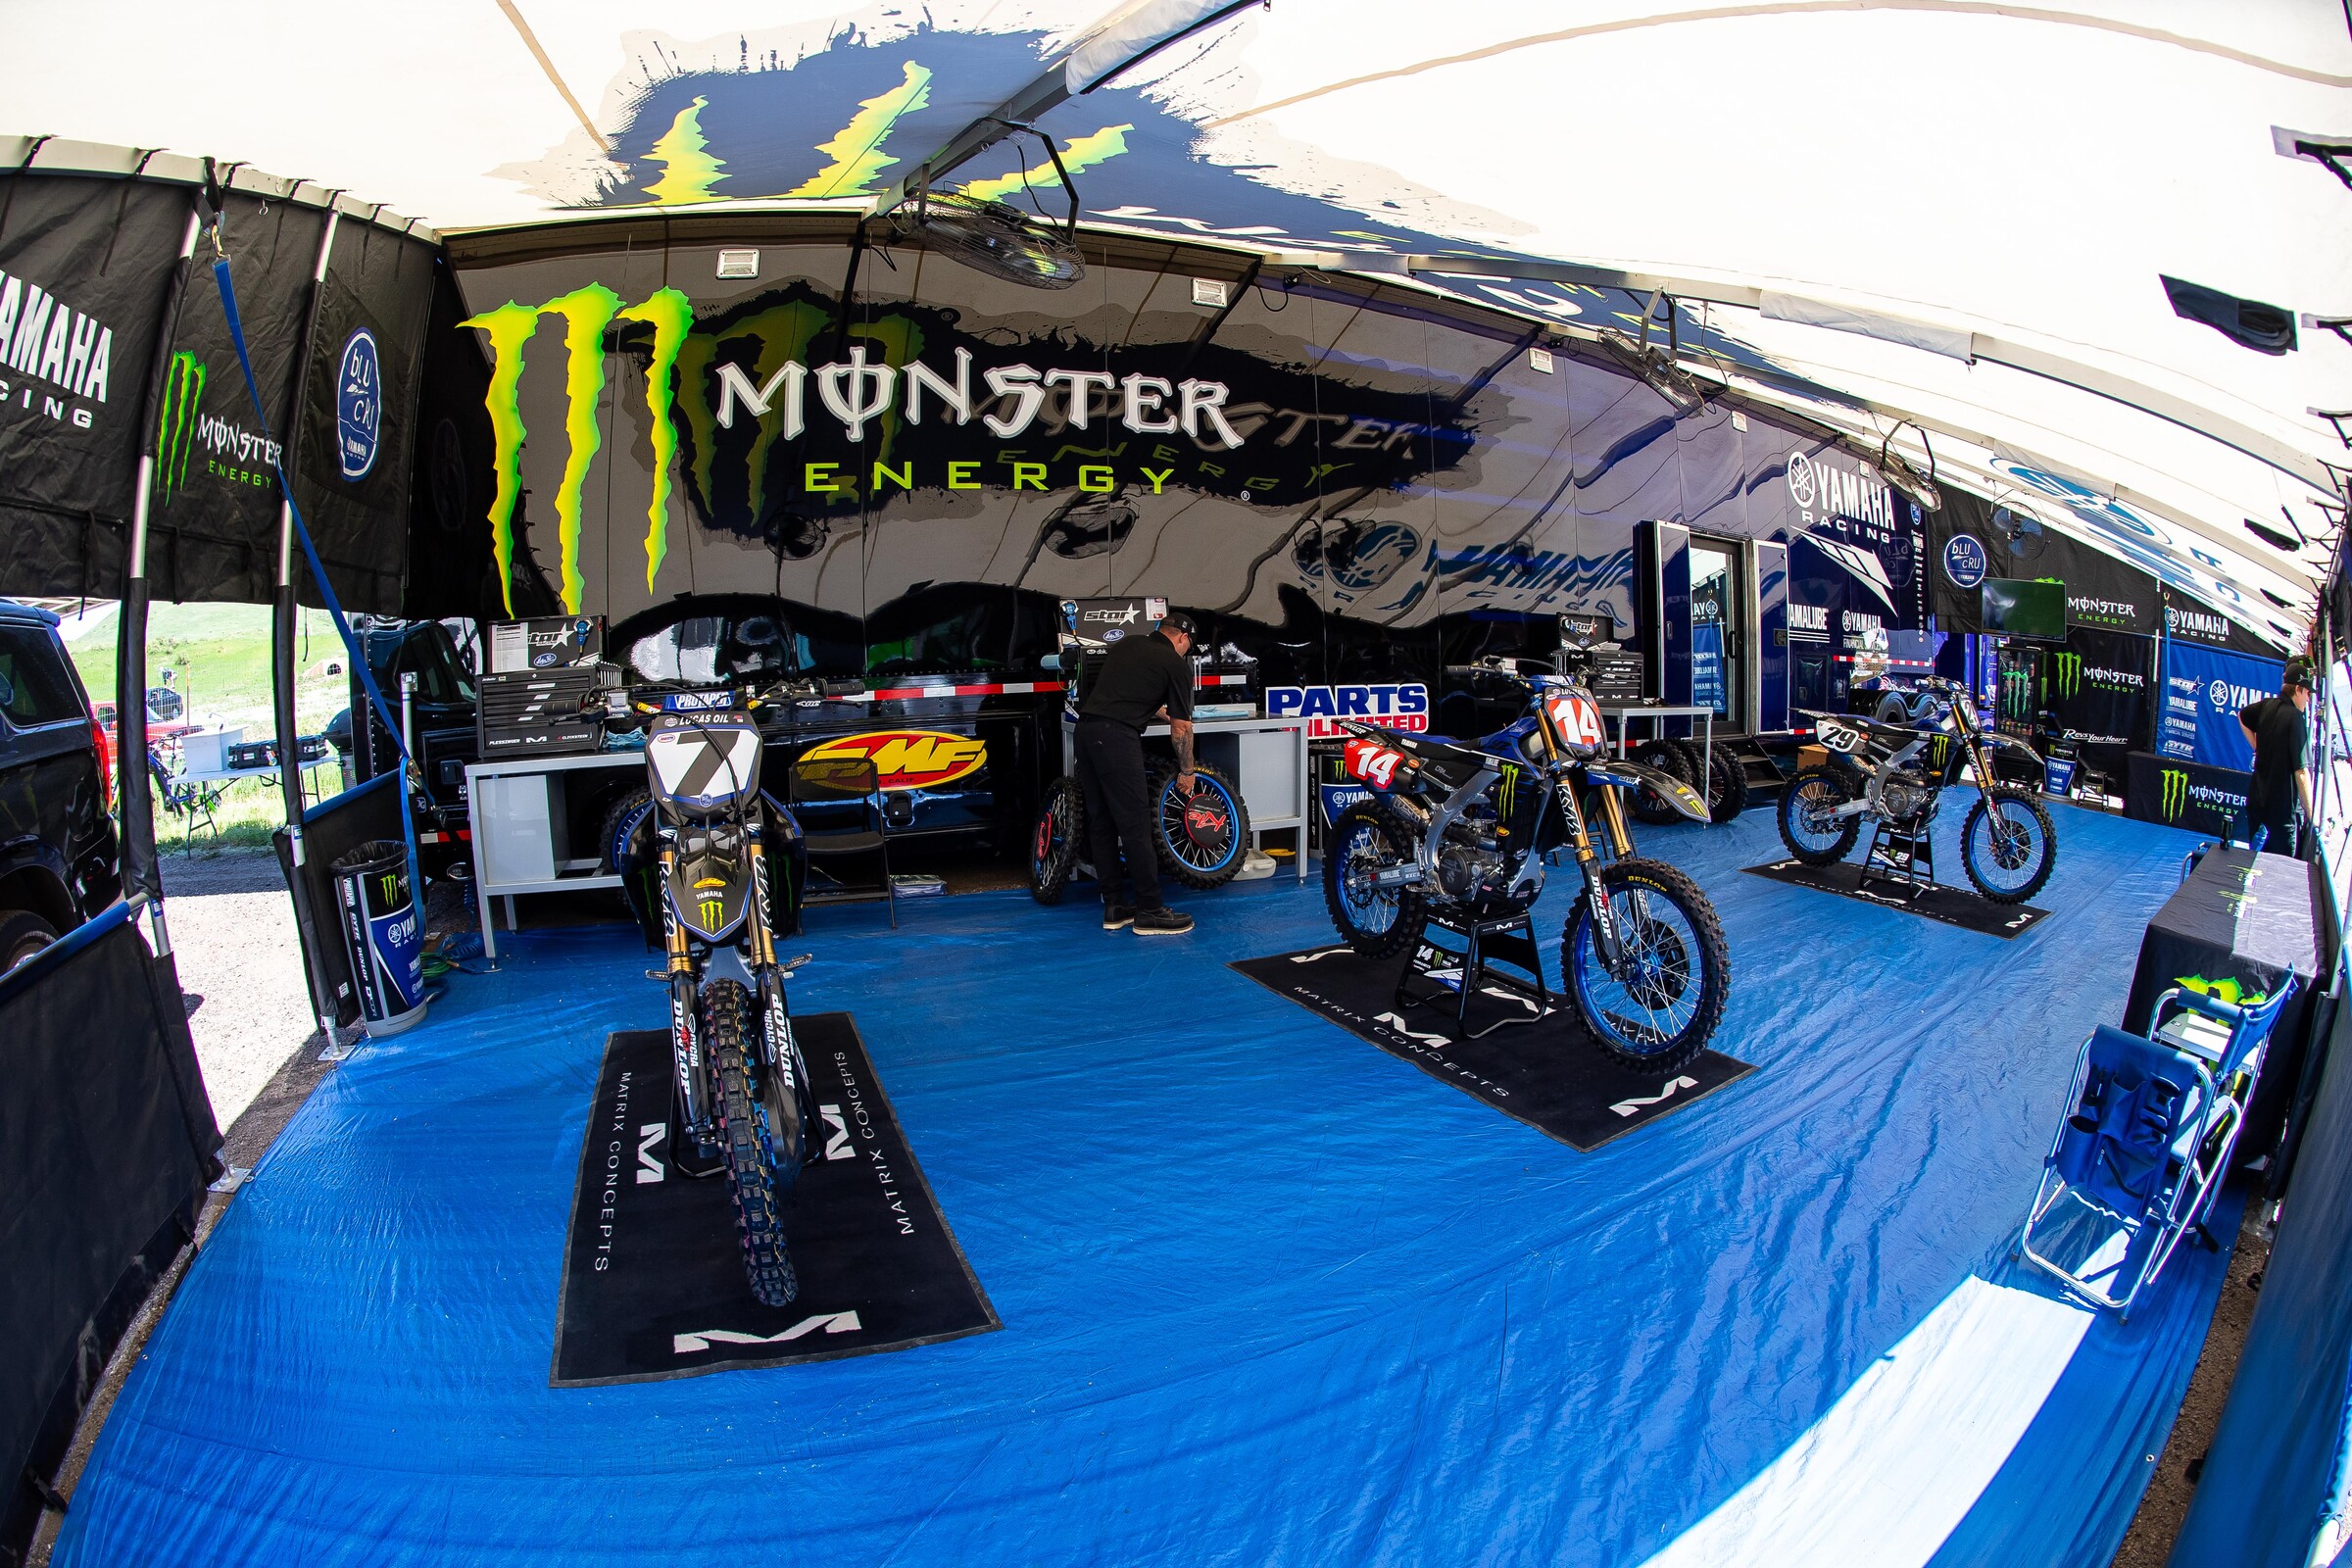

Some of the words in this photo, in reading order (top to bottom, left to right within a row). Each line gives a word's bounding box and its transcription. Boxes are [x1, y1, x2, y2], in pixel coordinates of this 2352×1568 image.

[0, 269, 113, 403] AMAHA
[714, 346, 1246, 449] MONSTER
[197, 413, 283, 470] MONSTER
[208, 460, 272, 488] ENERGY
[805, 461, 1175, 495] ENERGY
[1815, 462, 1896, 530] YAMAHA
[1801, 510, 1891, 544] RACING
[2068, 597, 2136, 618] MONSTER
[2078, 613, 2126, 625] ENERGY
[1851, 612, 1882, 632] YAMAHA
[2170, 627, 2227, 642] RACING
[2180, 611, 2230, 635] YAMAHA
[2083, 667, 2144, 687] MONSTER
[2092, 682, 2135, 694] ENERGY
[676, 692, 732, 708] PROTAPER
[1267, 685, 1427, 717] PARTS
[2230, 684, 2278, 709] YAMA
[679, 713, 710, 726] LUCAS
[712, 714, 729, 723] OIL
[1307, 714, 1427, 737] LITED
[1340, 722, 1366, 735] DUNLOP
[1553, 700, 1601, 745] 14
[2172, 717, 2196, 732] YAMAHA
[1821, 726, 1857, 750] 29
[672, 731, 740, 796] 7
[1193, 766, 1215, 776] UNLOP
[1356, 746, 1400, 785] 14
[1346, 791, 1375, 804] YAMA
[2197, 802, 2238, 815] ENERGY
[1355, 814, 1379, 825] DUNLOP
[1896, 851, 1910, 861] 29
[1379, 868, 1400, 879] YAMALUBE
[1628, 875, 1668, 892] DUNLOP
[695, 891, 723, 900] YAMAHA
[1592, 874, 1612, 939] DUNLOP
[401, 912, 416, 938] YAM
[357, 946, 368, 981] DUNLOP
[1415, 945, 1435, 961] 14
[1294, 986, 1366, 1023] MATRIX
[764, 1009, 775, 1043] CYCRA
[673, 999, 691, 1096] DUNLOP
[771, 993, 795, 1089] DUNLOP
[1373, 1026, 1509, 1097] CONCEPTS
[612, 1072, 632, 1131] MATRIX
[833, 1052, 875, 1140] CONCEPTS
[869, 1150, 915, 1235] MATRIX
[594, 1141, 621, 1271] CONCEPTS
